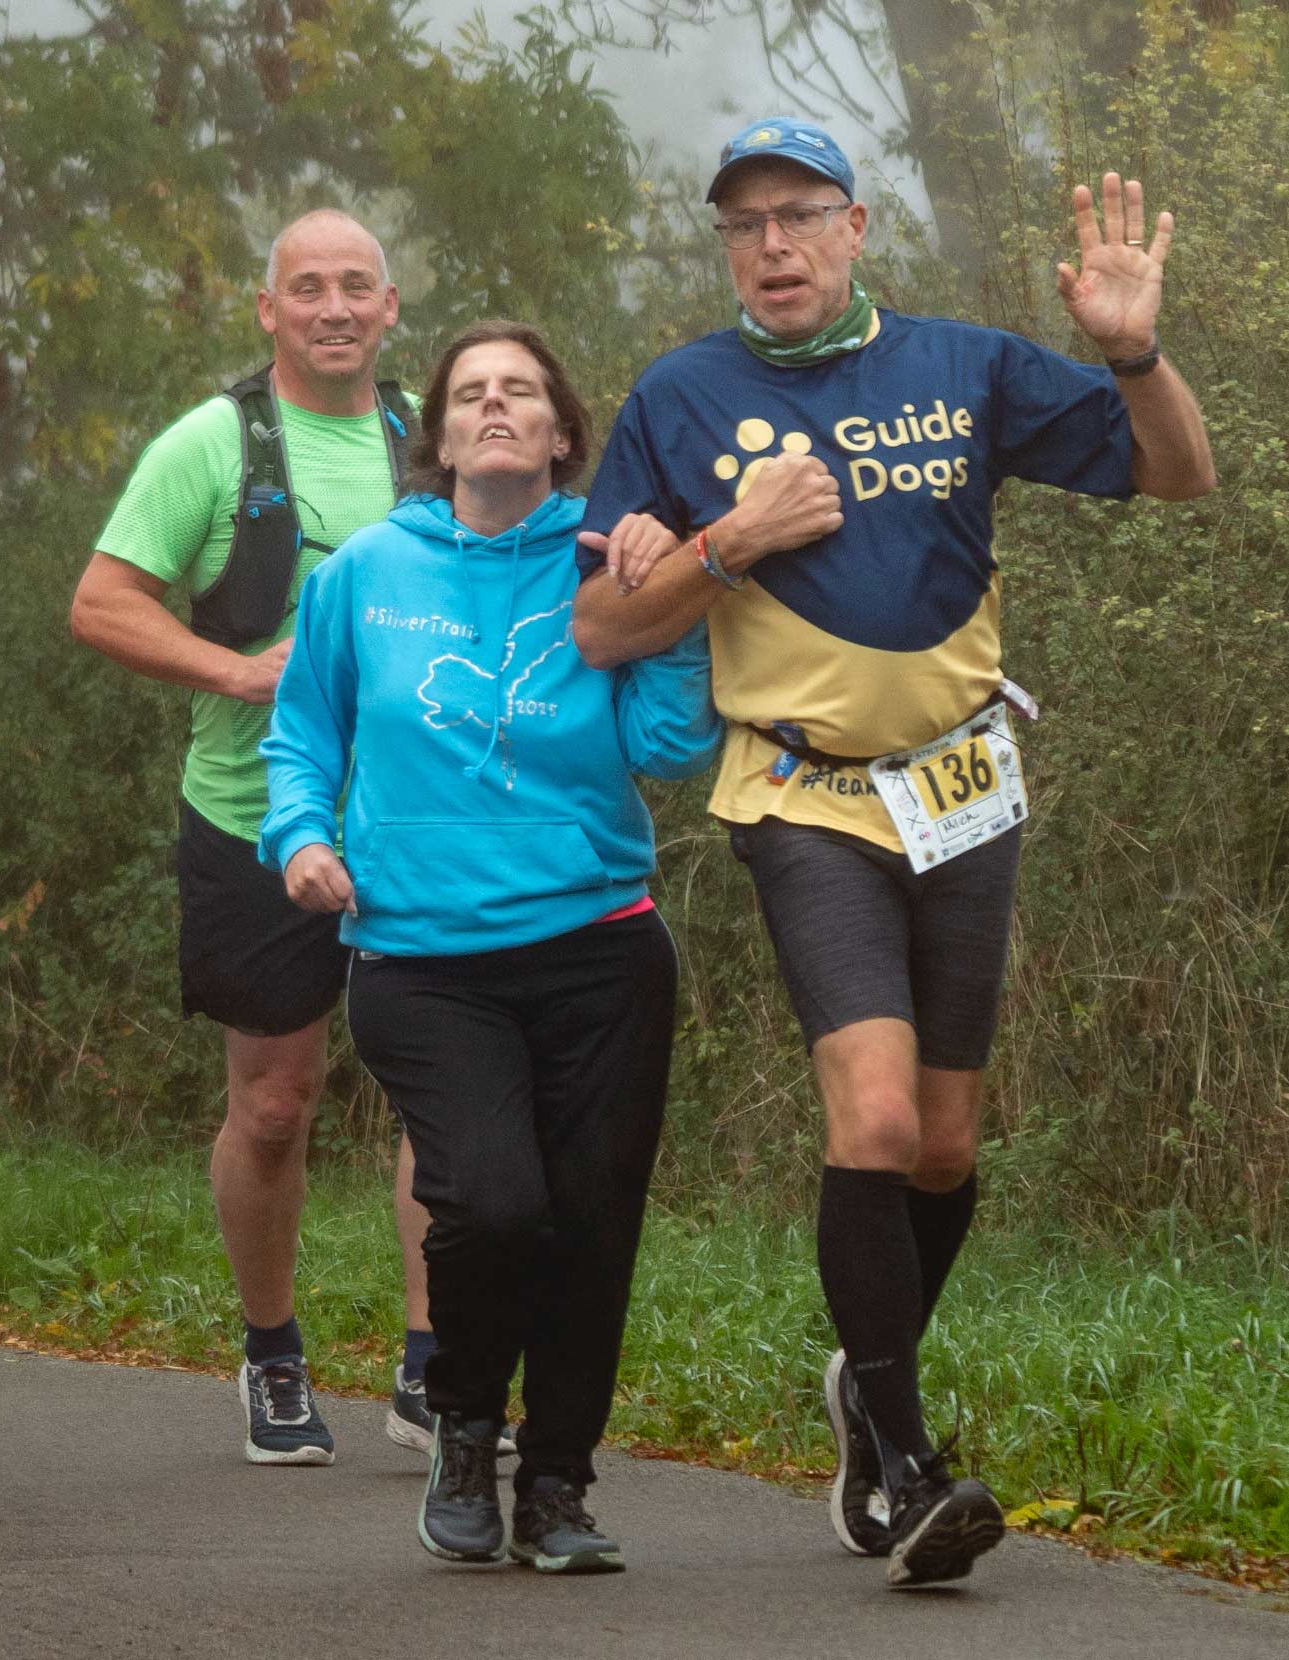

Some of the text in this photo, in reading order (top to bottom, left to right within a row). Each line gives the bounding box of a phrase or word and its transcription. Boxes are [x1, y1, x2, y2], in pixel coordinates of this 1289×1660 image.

[834, 399, 973, 452] Guide
[849, 456, 968, 501] Dogs
[920, 742, 993, 812] 136
